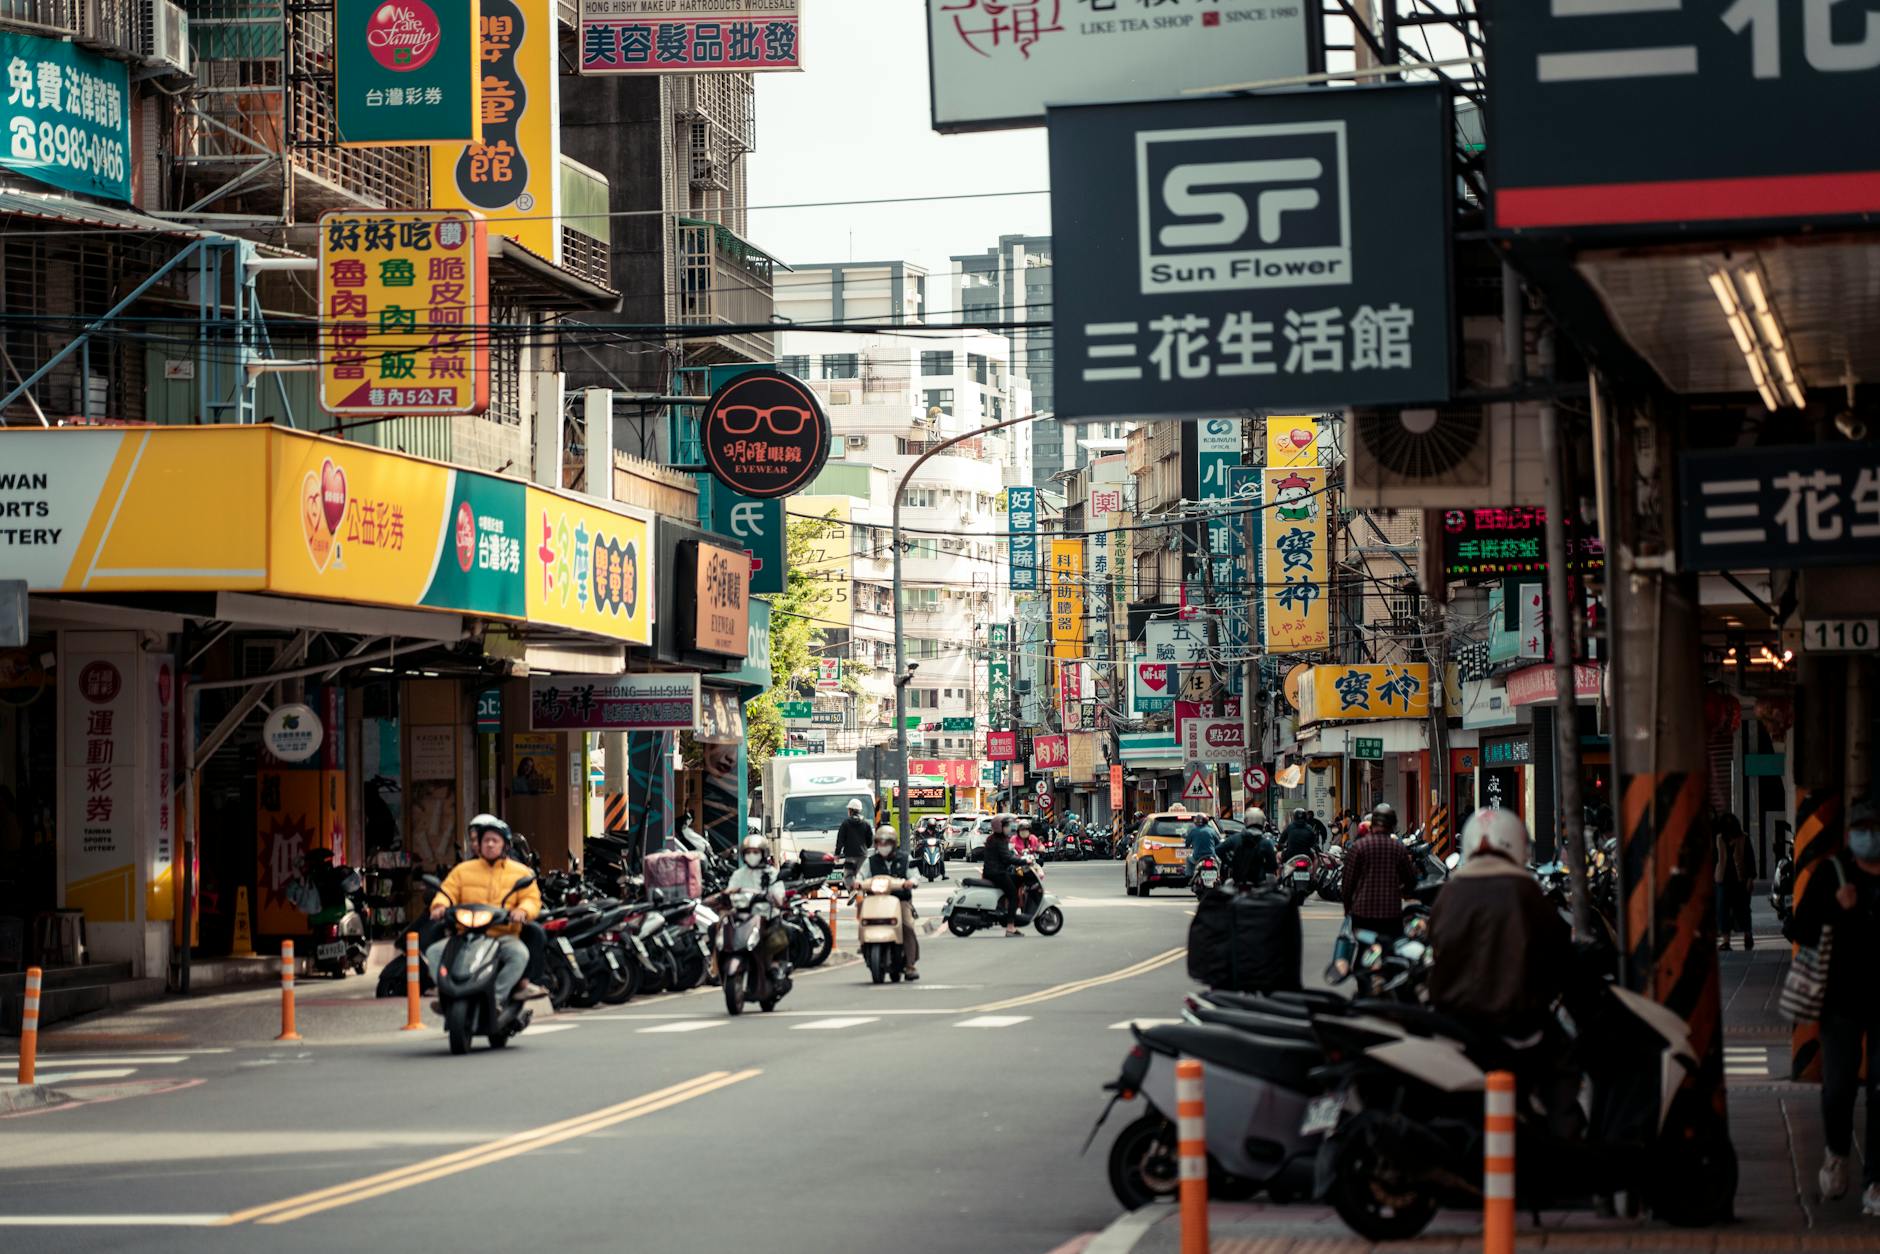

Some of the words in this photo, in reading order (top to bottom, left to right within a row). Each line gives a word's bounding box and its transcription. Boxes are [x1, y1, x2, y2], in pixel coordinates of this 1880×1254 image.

[390, 7, 415, 22] We
[586, 1, 609, 13] HONG
[613, 1, 637, 12] HISHY
[1080, 21, 1117, 36] LIKE
[1120, 19, 1150, 33] TEA
[1153, 14, 1194, 30] SHOP
[1225, 9, 1267, 24] SINCE
[1270, 7, 1298, 20] 1980
[367, 20, 440, 55] Family
[401, 19, 423, 32] are
[583, 22, 796, 63] 美容髮品批發
[365, 87, 443, 107] 台灣彩券
[39, 120, 124, 183] 8983-0466
[1158, 157, 1323, 247] SF
[328, 217, 433, 252] 好好吃
[1151, 263, 1216, 284] Sun
[1230, 256, 1343, 280] Flower
[378, 258, 417, 380] 魯肉飯
[1082, 302, 1415, 382] 三花生活館
[368, 388, 454, 406] 巷內5公尺
[734, 464, 789, 475] EYEWEAR
[346, 498, 404, 551] 公益彩券
[1010, 490, 1034, 589] 好客多蔬果
[478, 532, 520, 575] 台灣彩券
[1814, 621, 1869, 648] 110
[604, 685, 637, 697] HONG
[649, 685, 690, 697] HISHY
[1334, 669, 1421, 712] 寶神
[86, 709, 114, 823] 運動彩券
